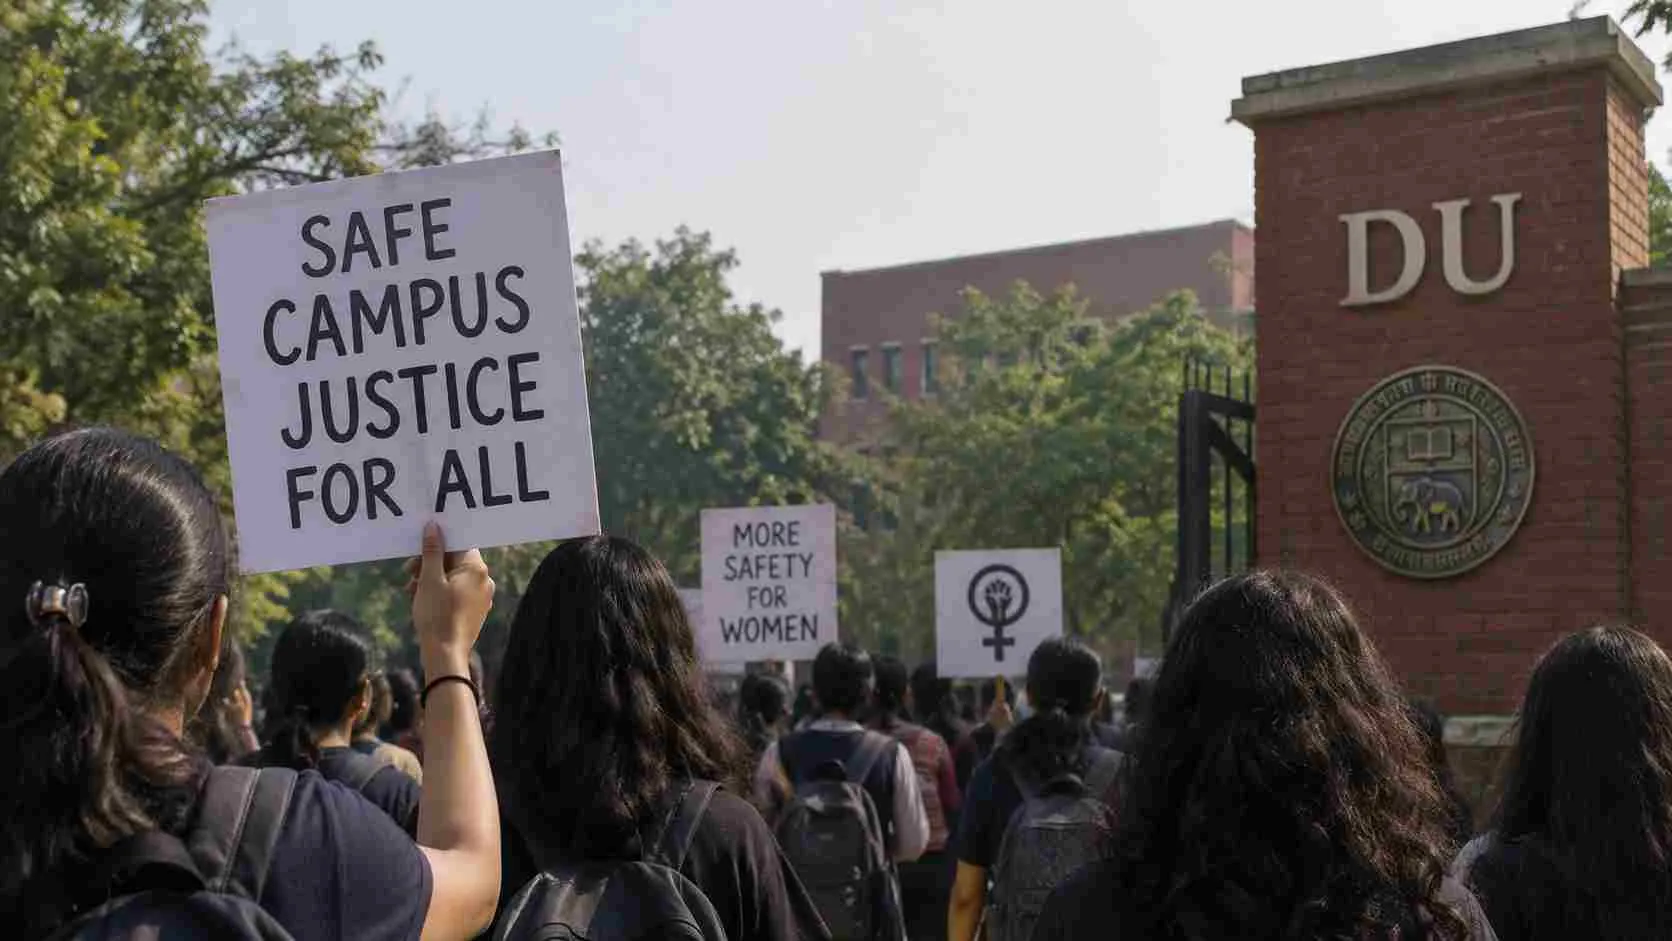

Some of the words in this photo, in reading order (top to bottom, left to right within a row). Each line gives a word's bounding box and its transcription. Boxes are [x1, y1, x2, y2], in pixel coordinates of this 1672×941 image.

[300, 197, 457, 278] SAFE
[1337, 192, 1522, 306] DU
[262, 265, 531, 366] CAMPUS
[280, 351, 545, 450] JUSTICE
[286, 457, 404, 530] FOR
[434, 440, 550, 513] ALL
[723, 552, 814, 582] SAFETY
[733, 520, 801, 549] MORE
[719, 614, 819, 644] WOMEN
[747, 584, 788, 609] FOR
